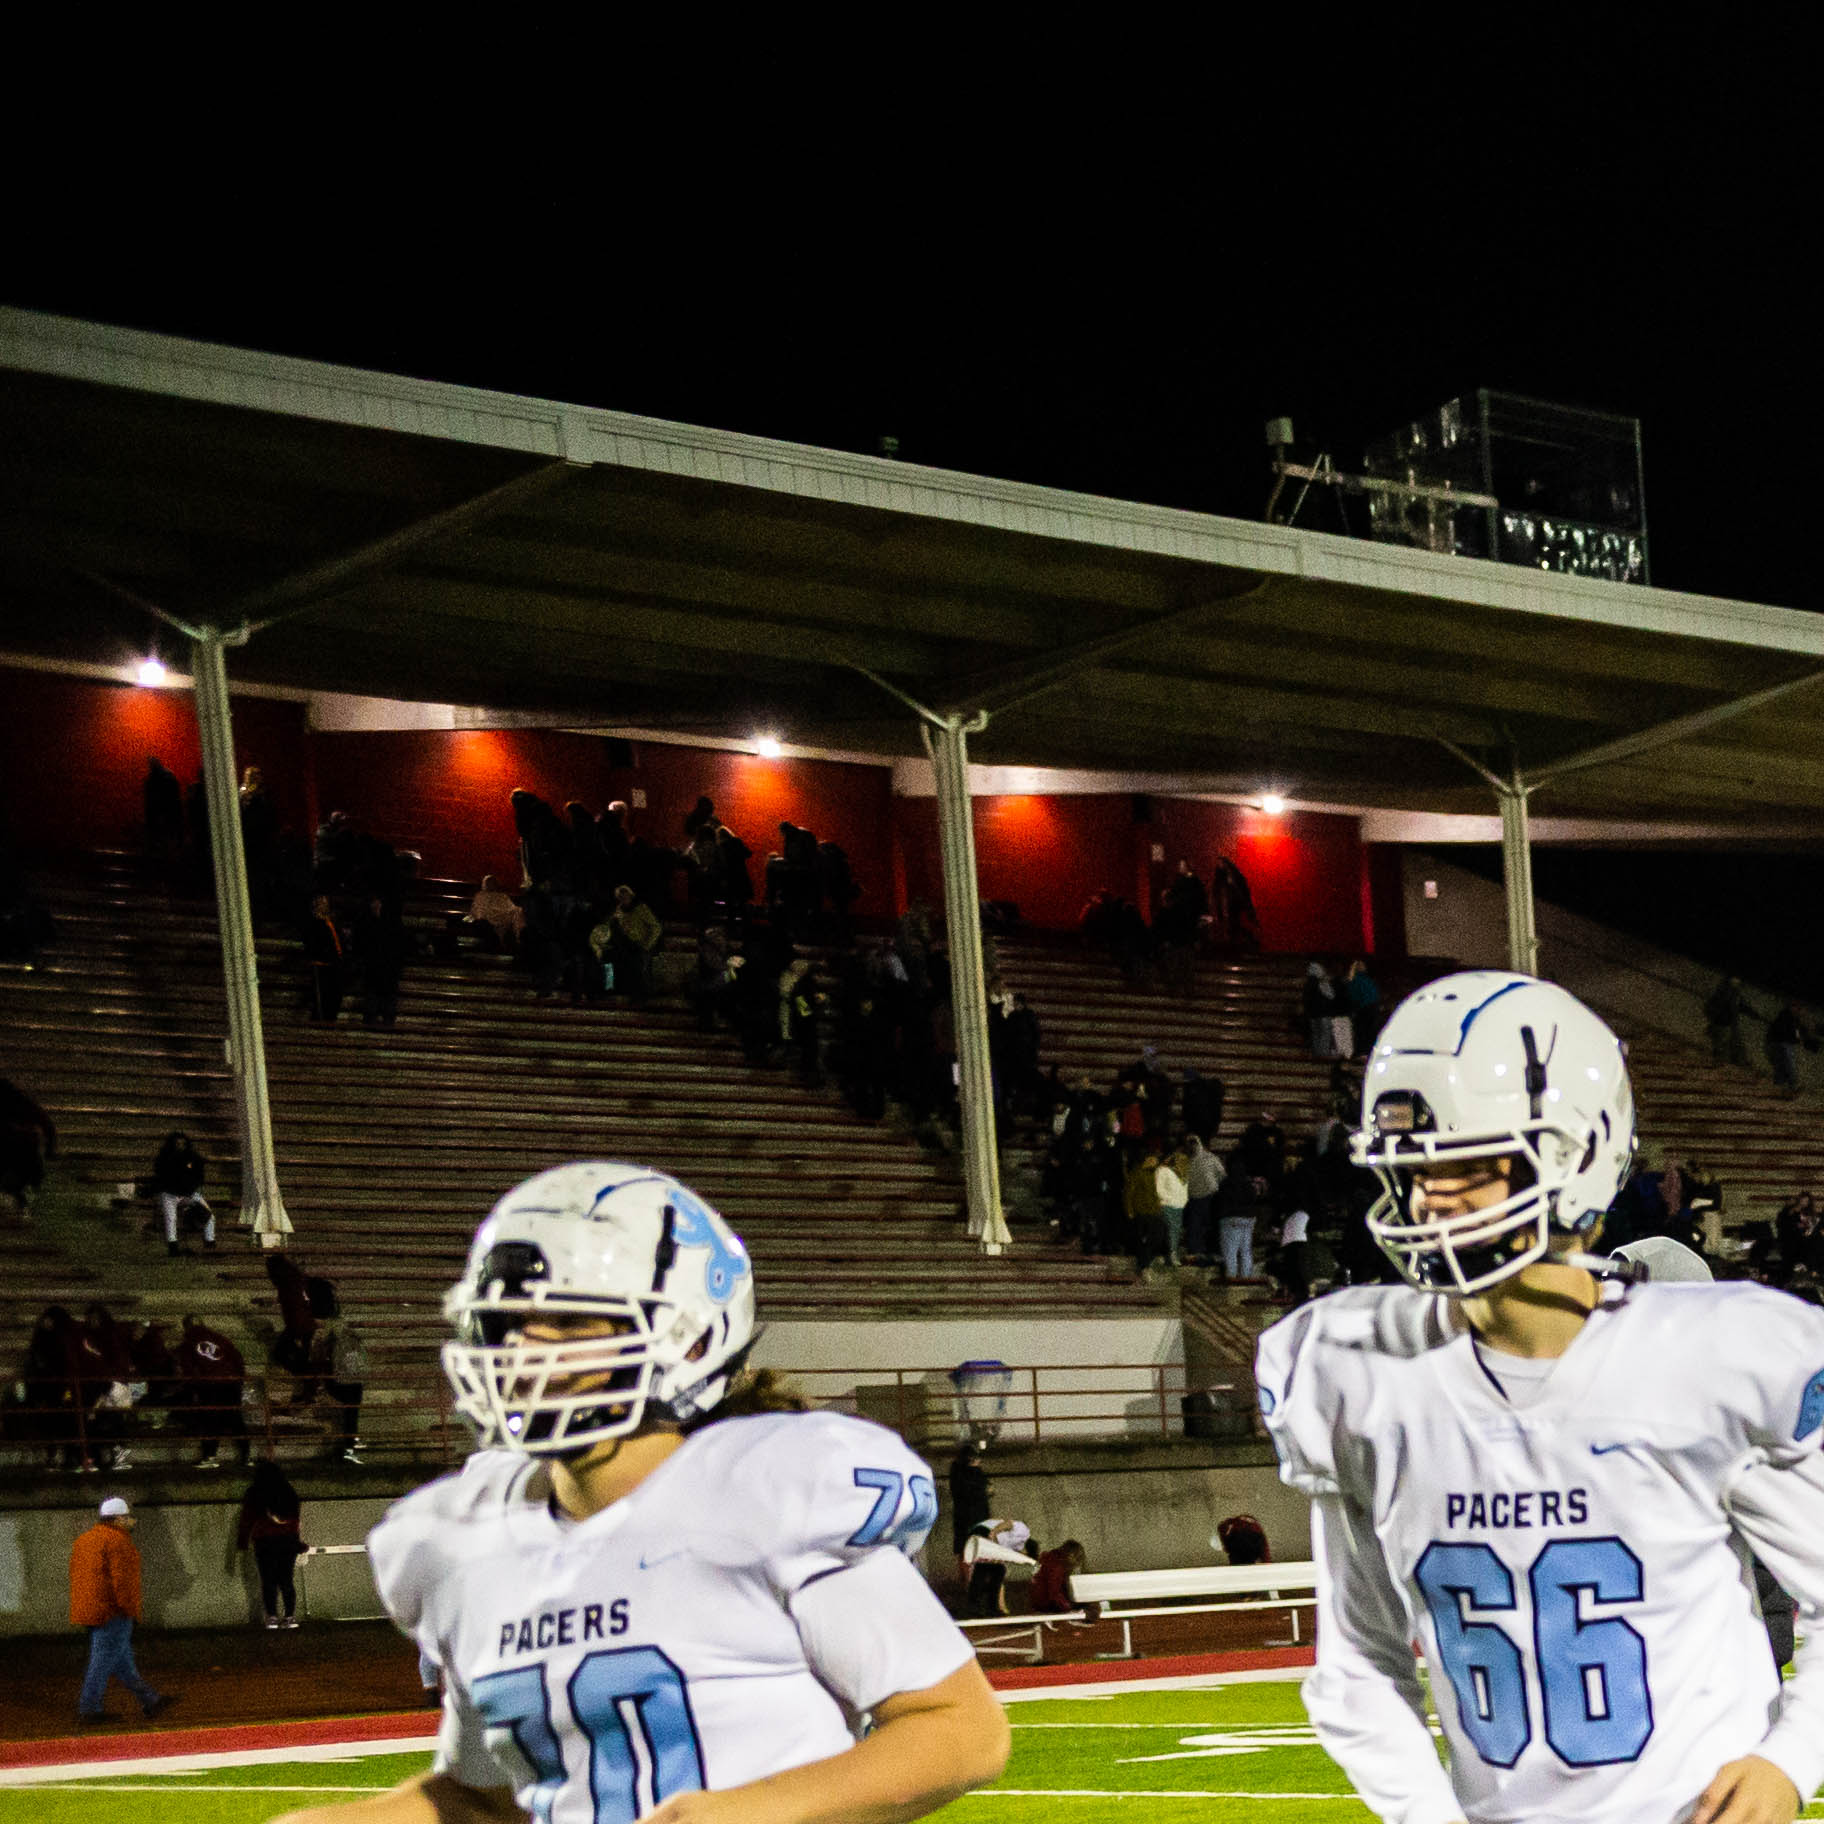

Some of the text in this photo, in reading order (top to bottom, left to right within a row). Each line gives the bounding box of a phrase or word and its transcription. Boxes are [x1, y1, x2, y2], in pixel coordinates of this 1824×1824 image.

[1447, 1488, 1589, 1529] PACERS
[499, 1598, 631, 1658] PACERS
[1413, 1536, 1655, 1770] 66
